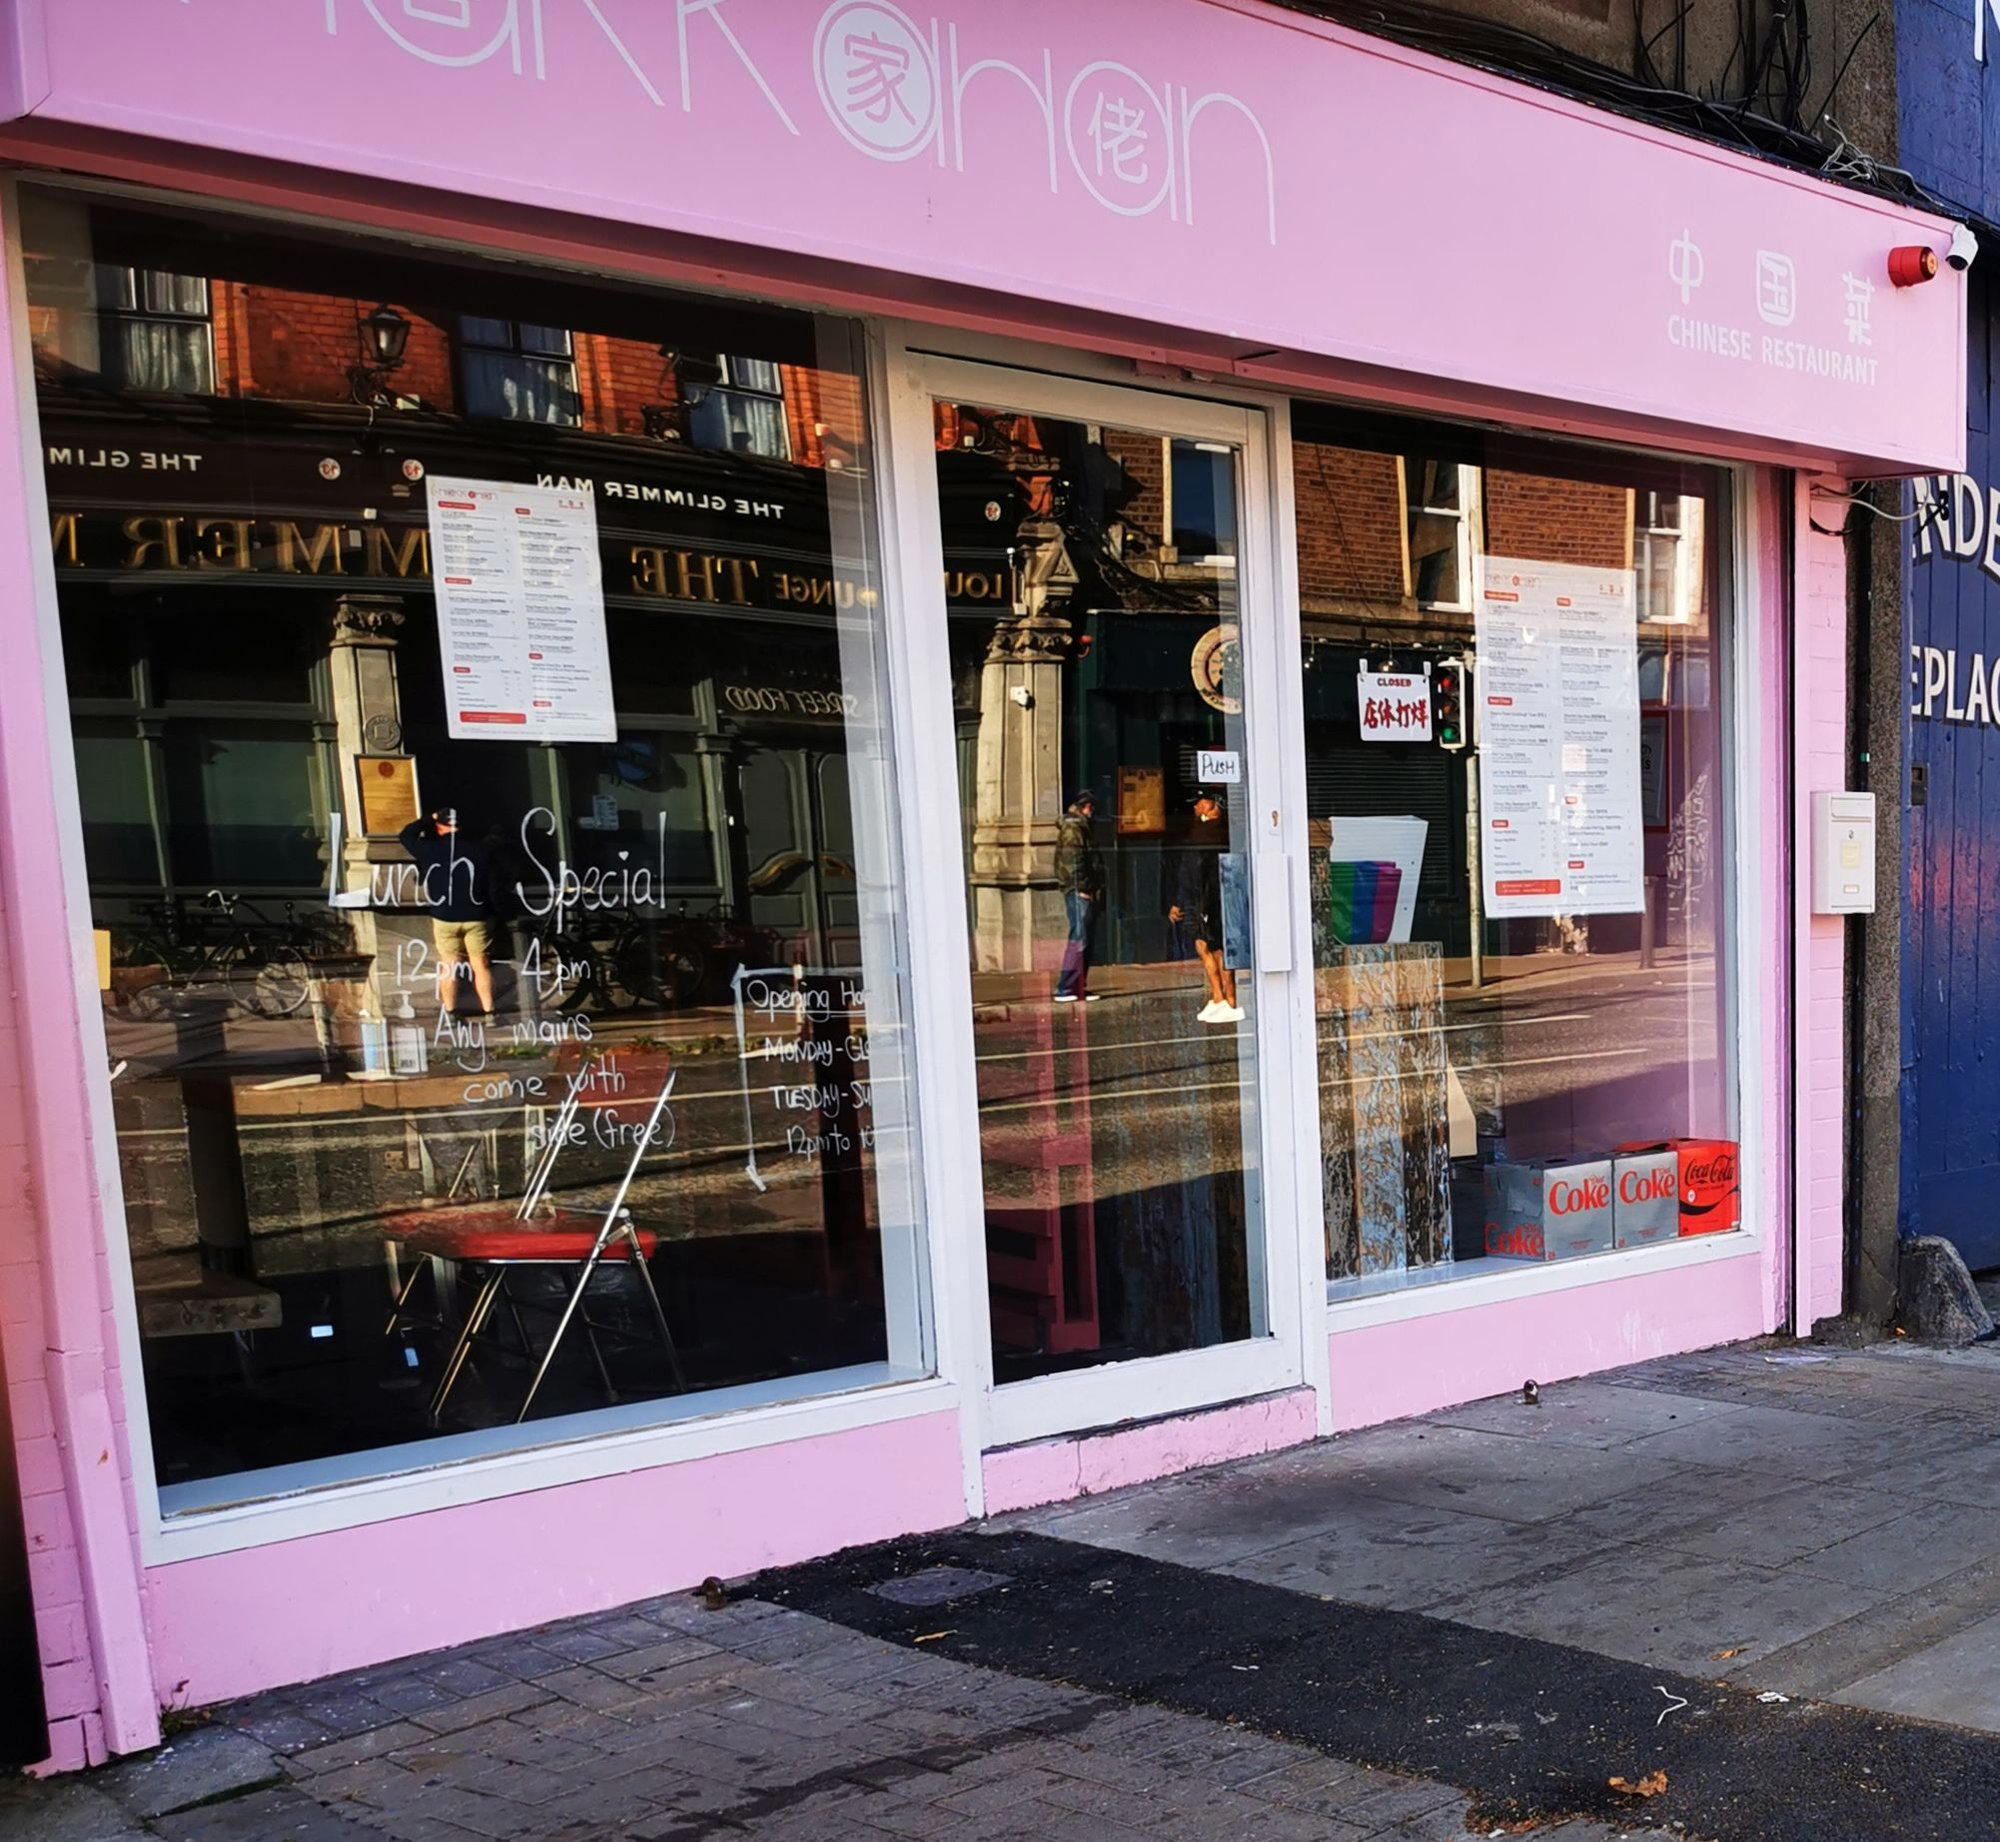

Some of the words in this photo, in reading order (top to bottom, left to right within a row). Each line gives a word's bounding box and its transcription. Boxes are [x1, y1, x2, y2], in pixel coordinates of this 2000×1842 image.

[842, 31, 917, 127] 家
[1087, 91, 1148, 185] 佬
[1667, 315, 1752, 362] CHINESE
[1762, 336, 1879, 386] RESTAURANT
[1912, 474, 2000, 577] NDE
[1377, 677, 1412, 687] CLOSED
[1202, 753, 1235, 777] PUSH
[328, 809, 484, 907] Lunch
[515, 806, 667, 934] Special
[396, 938, 474, 1000] 12pm
[521, 937, 592, 996] 4pm
[747, 979, 830, 1023] Opening
[434, 1003, 486, 1073] Any
[512, 1010, 594, 1046] mains
[463, 1075, 547, 1103] come
[567, 1055, 626, 1094] with
[593, 1105, 676, 1150] (free)
[1549, 1178, 1610, 1216] Coke
[1619, 1168, 1676, 1204] Coke
